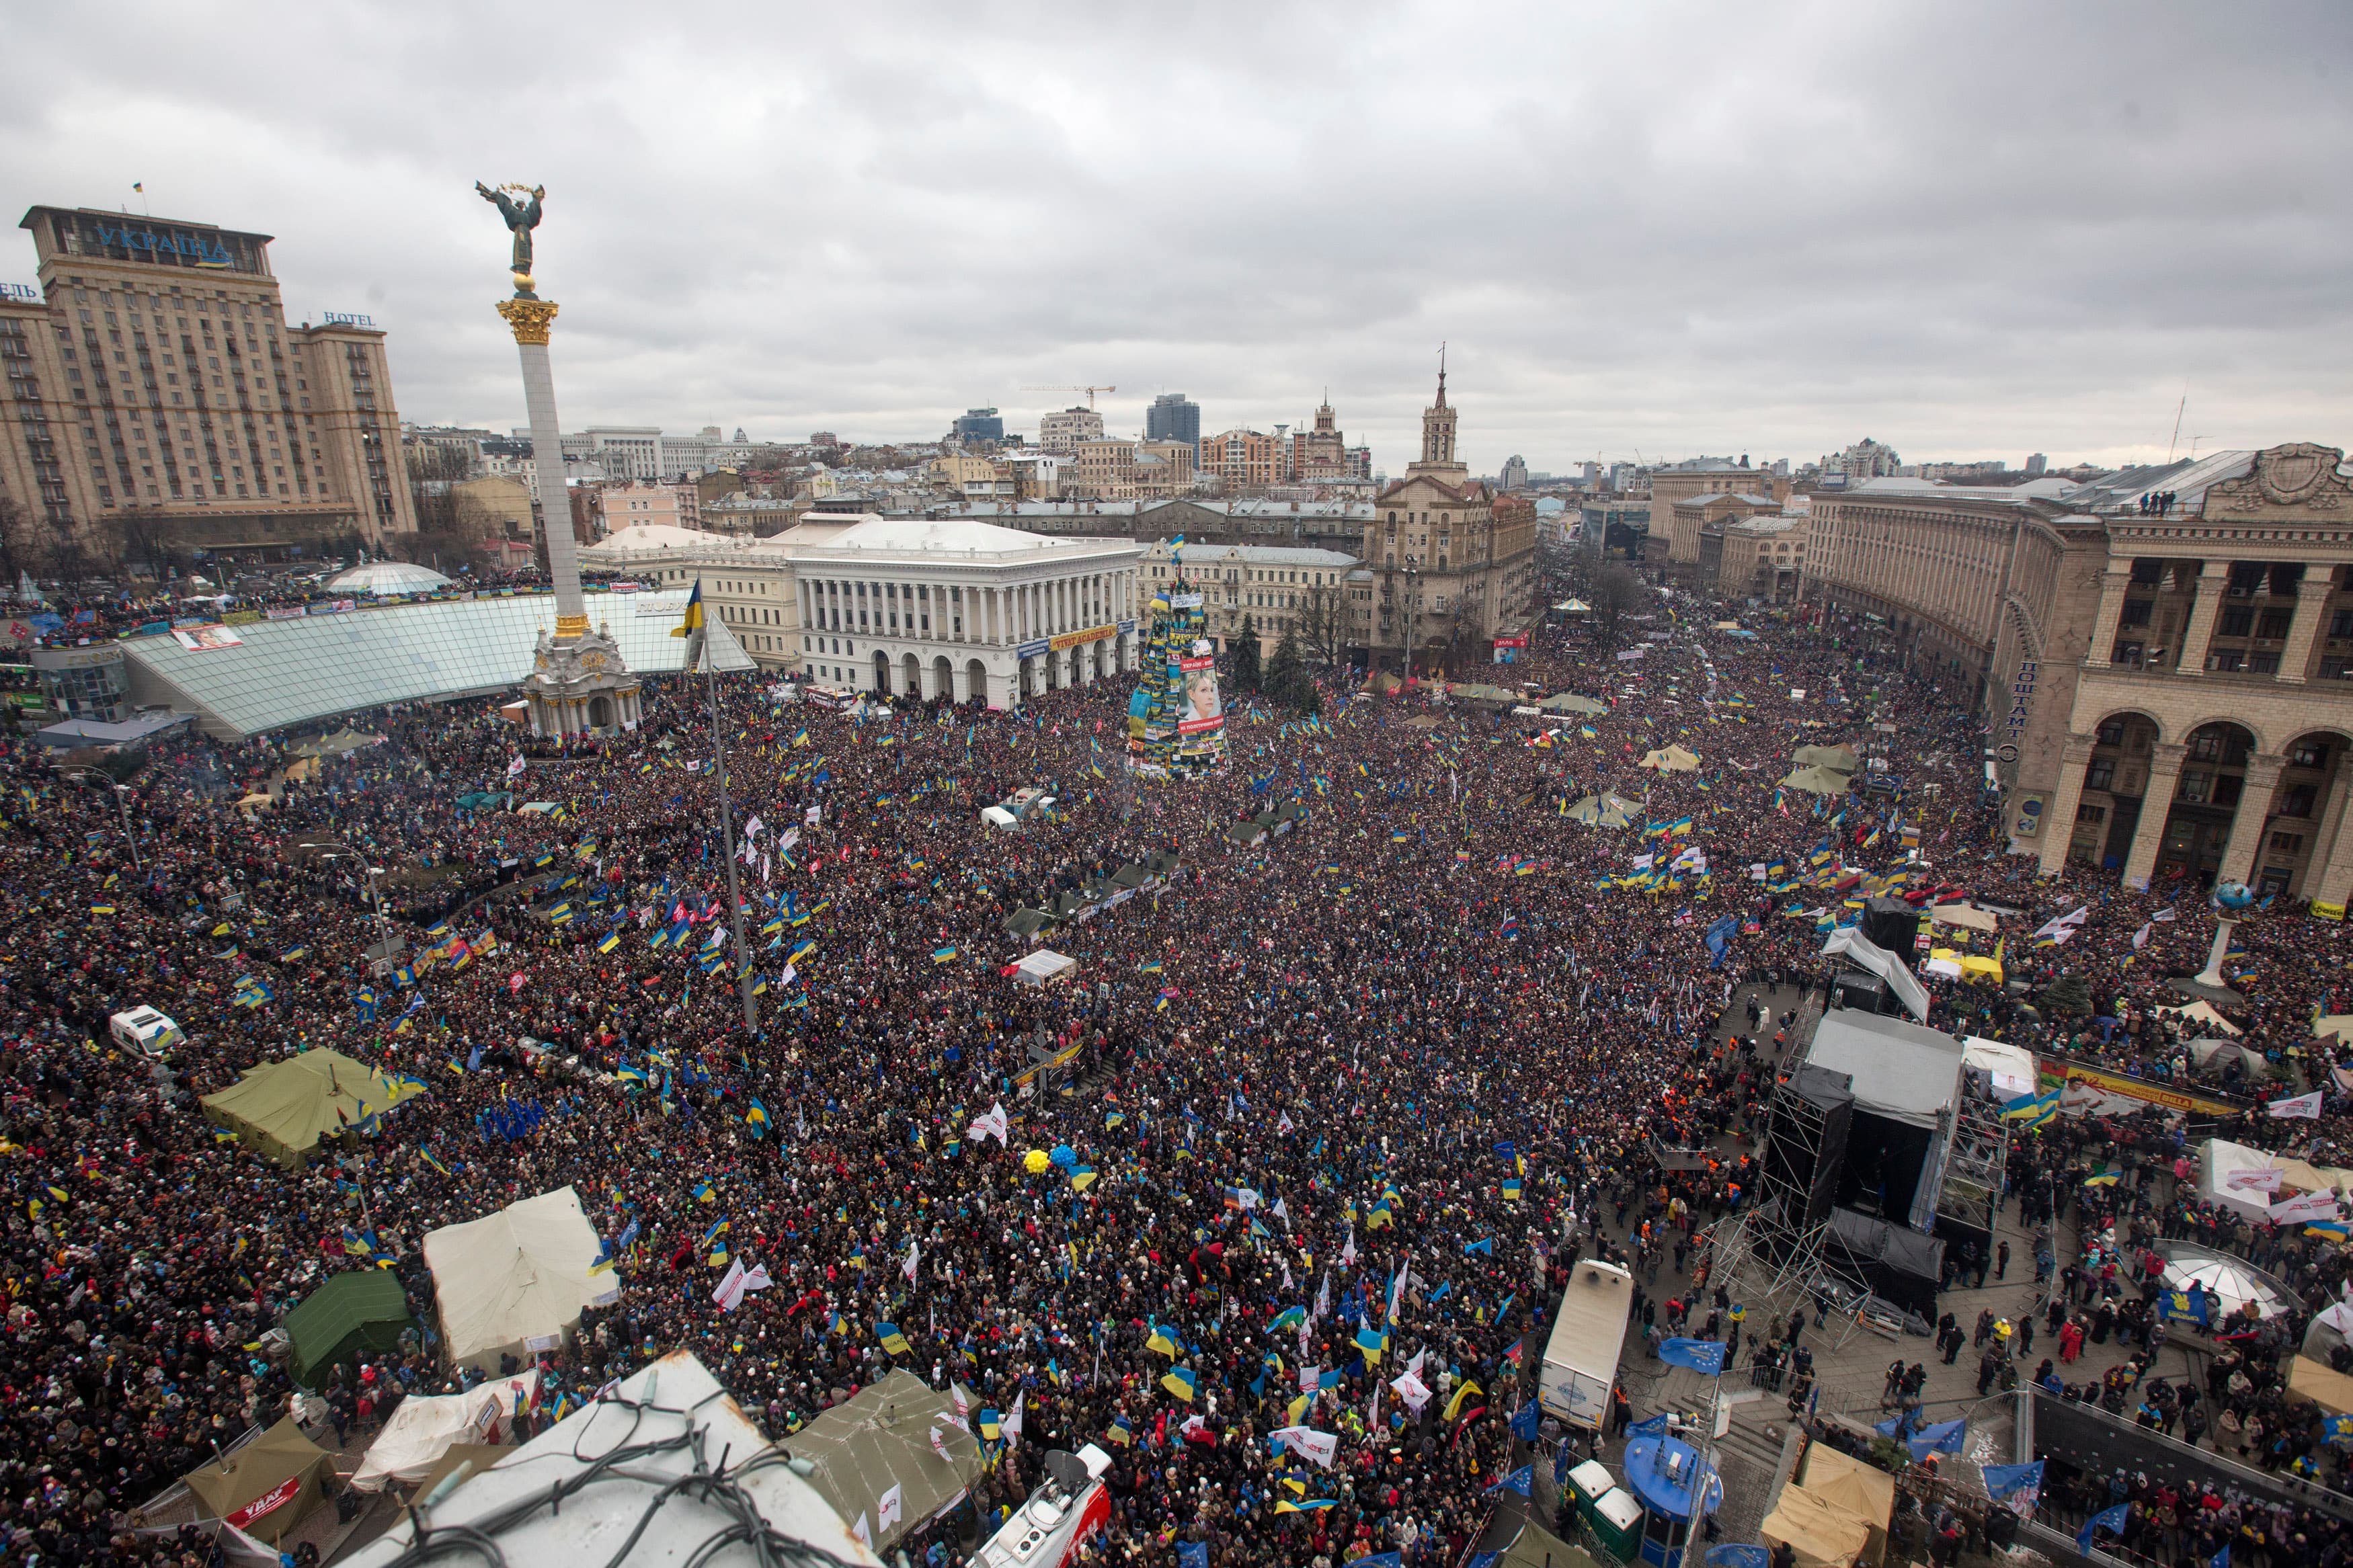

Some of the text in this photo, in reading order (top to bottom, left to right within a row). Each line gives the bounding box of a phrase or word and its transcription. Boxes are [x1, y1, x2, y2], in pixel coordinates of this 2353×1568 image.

[95, 226, 229, 258] УКРАЇНА
[0, 283, 36, 297] ЕЛЬ
[324, 312, 376, 325] HOTEL
[2006, 662, 2037, 738] ПОШТАМТ
[2110, 1084, 2159, 1101] СУПЕРМАРКЕТ
[2136, 1086, 2159, 1096] НОВИЙ
[2162, 1094, 2190, 1106] BILLA
